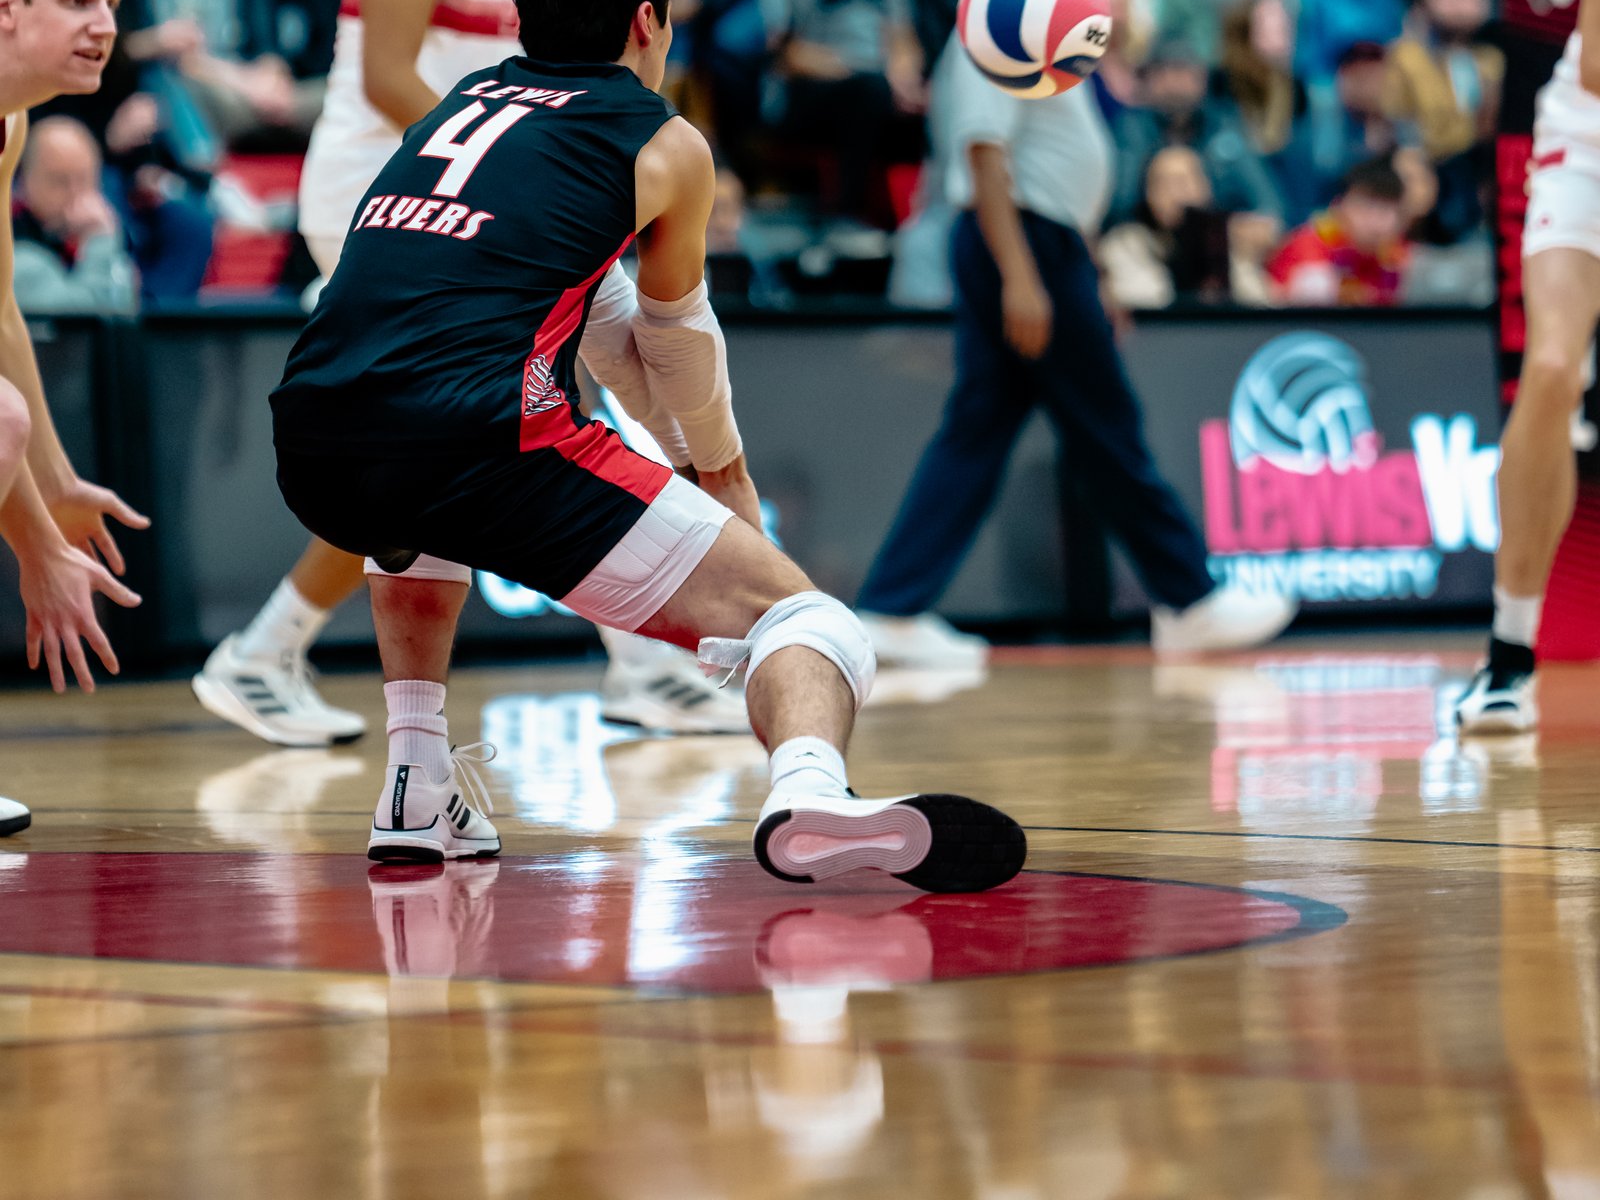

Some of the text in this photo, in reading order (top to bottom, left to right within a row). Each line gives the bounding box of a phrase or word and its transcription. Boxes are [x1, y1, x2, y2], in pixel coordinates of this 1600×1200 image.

[460, 80, 588, 109] LEWIS
[417, 99, 535, 199] 4
[353, 194, 495, 241] FLYERS
[1205, 548, 1441, 600] UNIVERSITY
